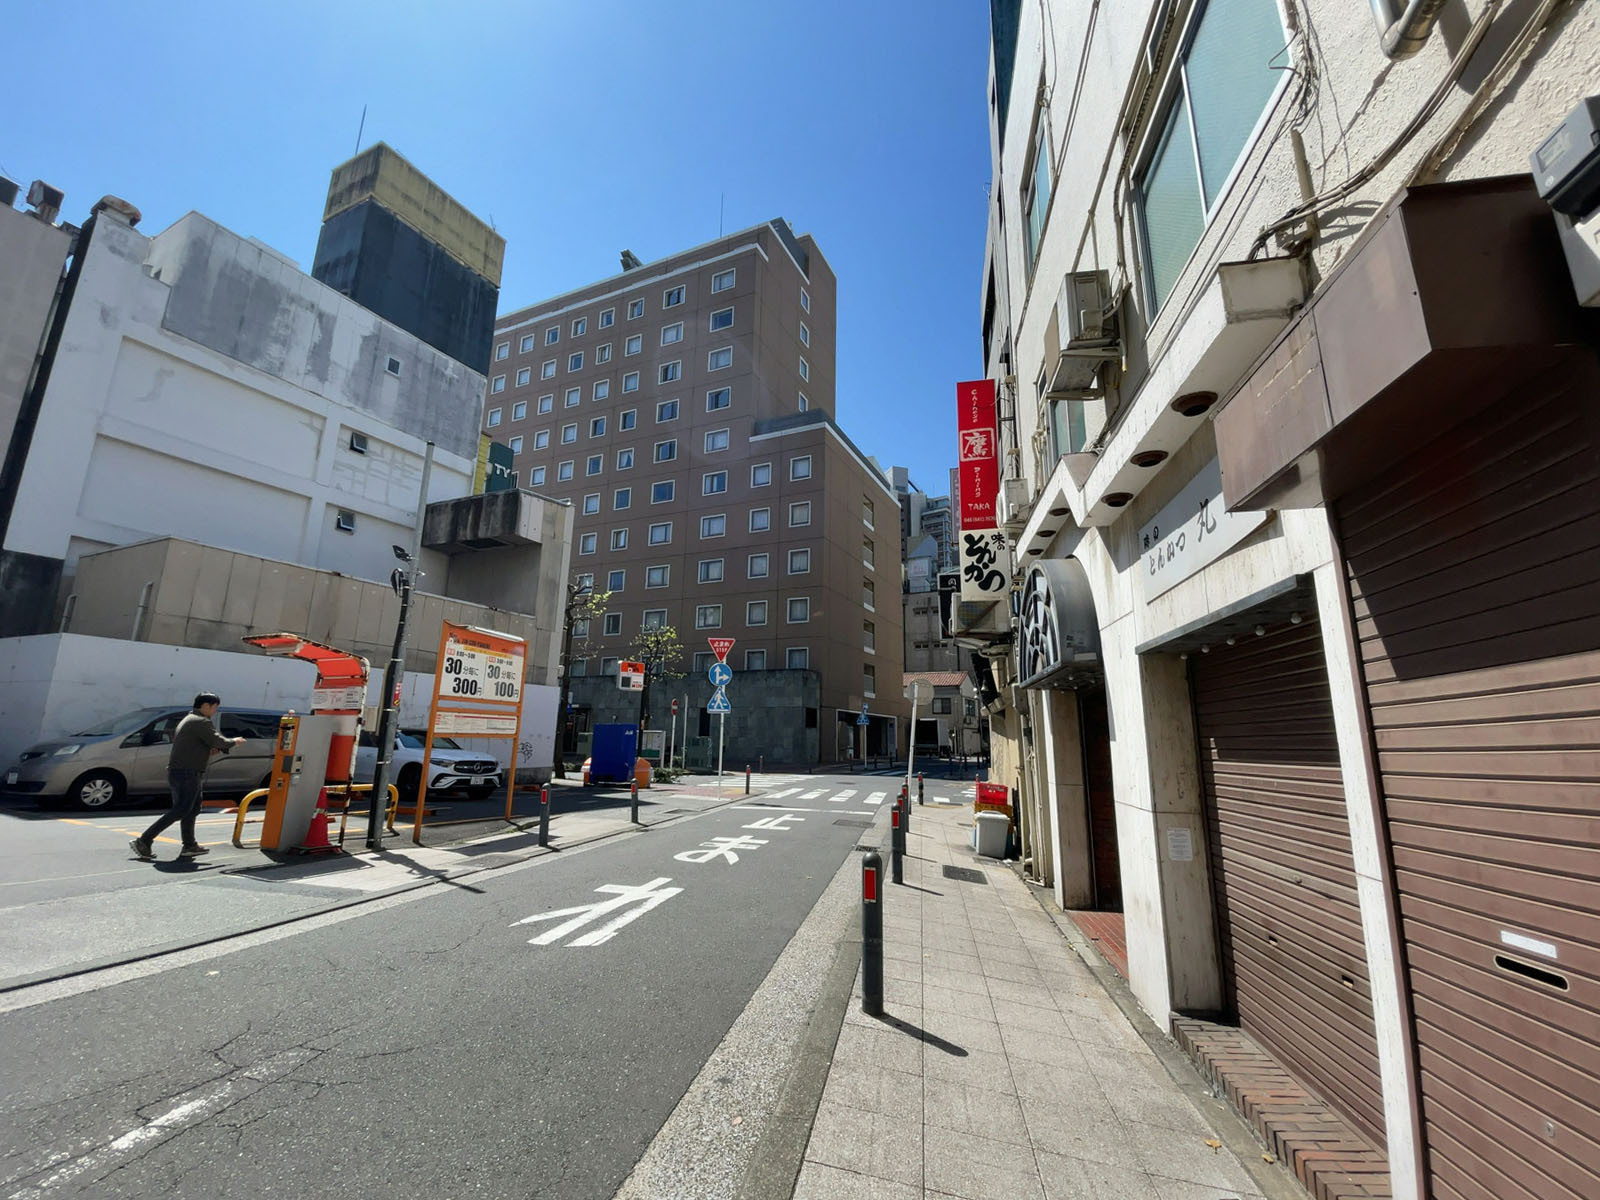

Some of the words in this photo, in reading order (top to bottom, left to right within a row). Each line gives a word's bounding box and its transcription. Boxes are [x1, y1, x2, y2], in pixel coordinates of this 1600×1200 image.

[967, 502, 991, 510] TAKA
[991, 532, 1005, 550] 味の
[1149, 532, 1186, 576] とんかつ
[963, 533, 1006, 593] とんかつ
